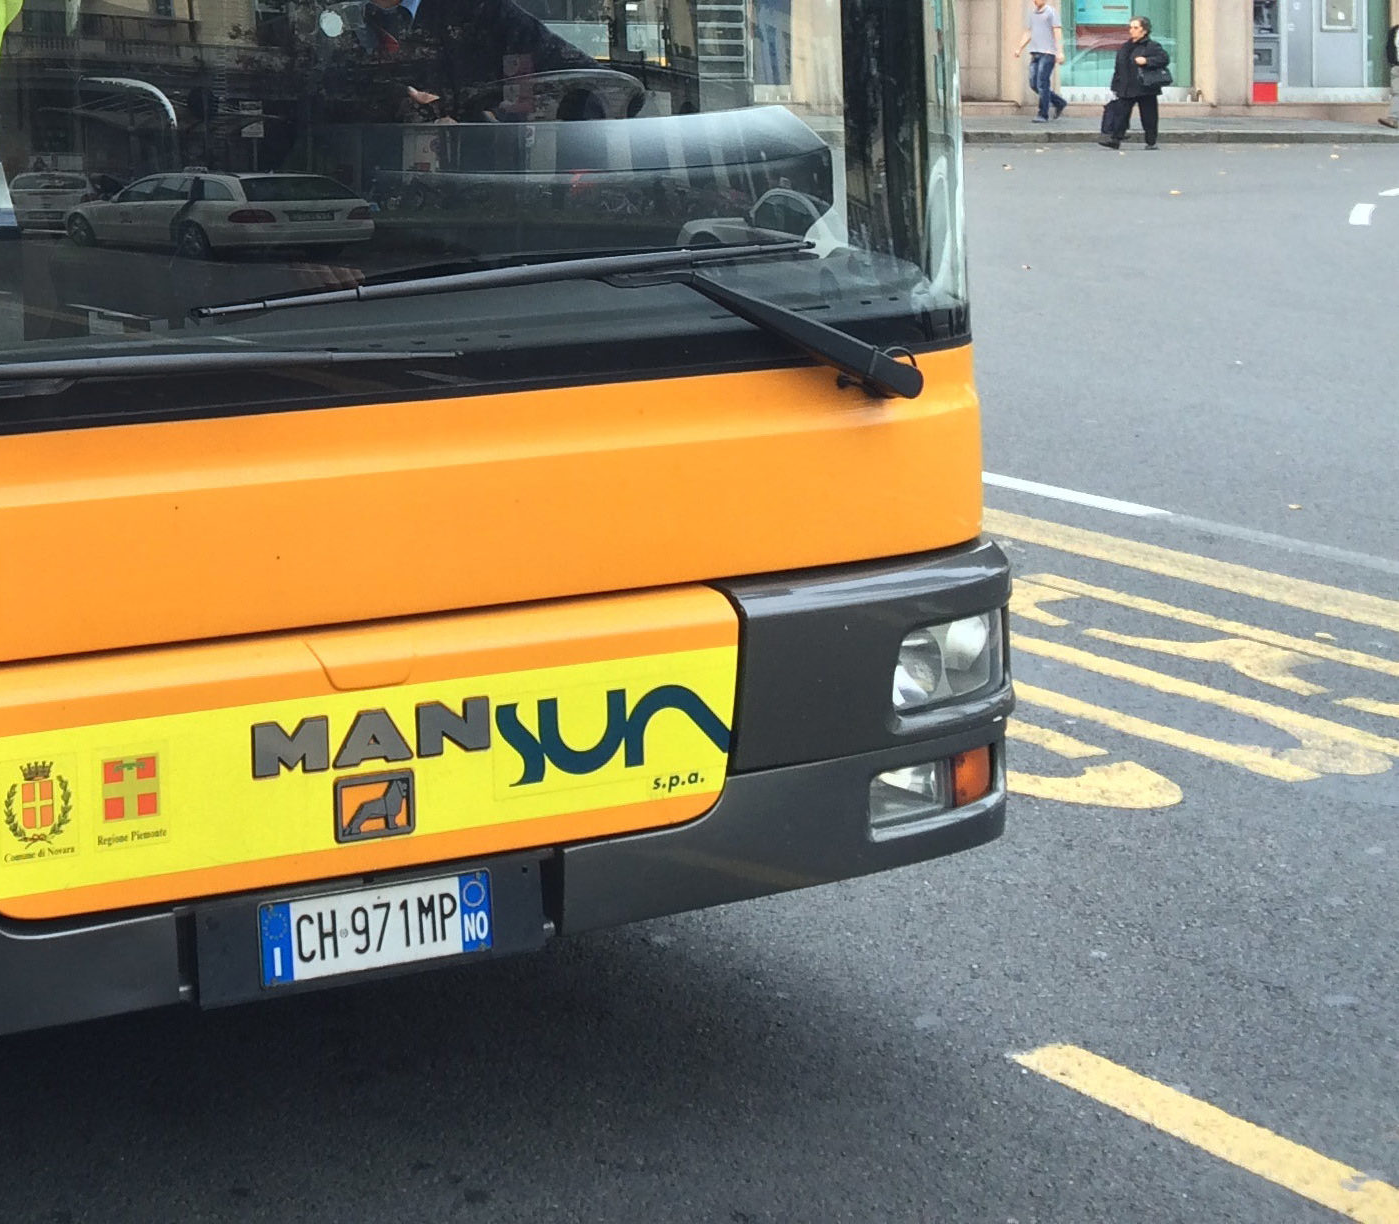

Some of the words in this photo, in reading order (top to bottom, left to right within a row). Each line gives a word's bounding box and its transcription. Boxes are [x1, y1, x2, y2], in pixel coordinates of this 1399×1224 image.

[251, 695, 491, 781] MAN
[97, 833, 128, 847] Regione
[131, 828, 167, 842] Piemonte
[4, 851, 35, 863] Comune
[37, 847, 45, 858] di
[47, 846, 75, 857] Novara
[463, 910, 489, 943] NO
